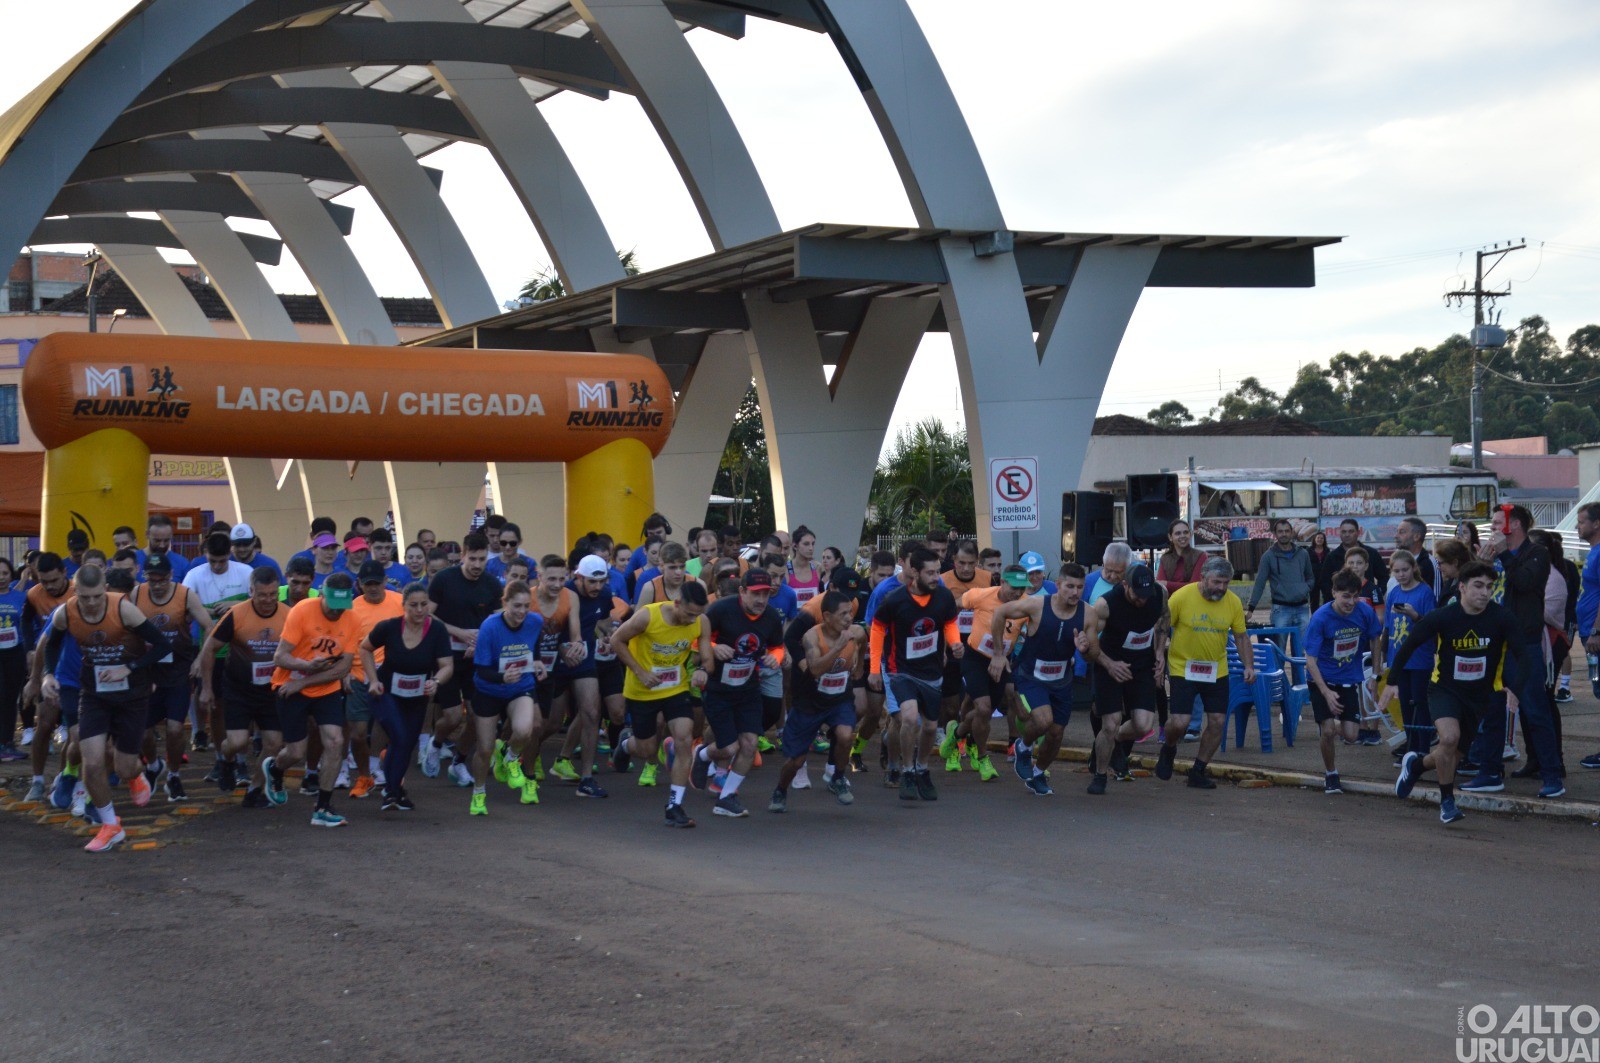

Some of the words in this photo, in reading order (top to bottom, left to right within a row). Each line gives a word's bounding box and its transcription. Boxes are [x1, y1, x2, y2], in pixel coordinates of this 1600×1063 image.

[85, 365, 134, 397] M1
[216, 385, 371, 414] LARGADA
[379, 391, 388, 415] /
[398, 392, 545, 416] CHEGADA
[578, 381, 618, 408] M1
[73, 399, 191, 418] RUNNING
[567, 411, 663, 427] RUNNING
[165, 461, 227, 478] PRAÇ
[993, 514, 1037, 522] ESTACIONAR
[998, 506, 1032, 514] PROIBIDO
[311, 638, 336, 655] JR
[1452, 638, 1478, 647] LEVEL
[1479, 637, 1490, 646] UP
